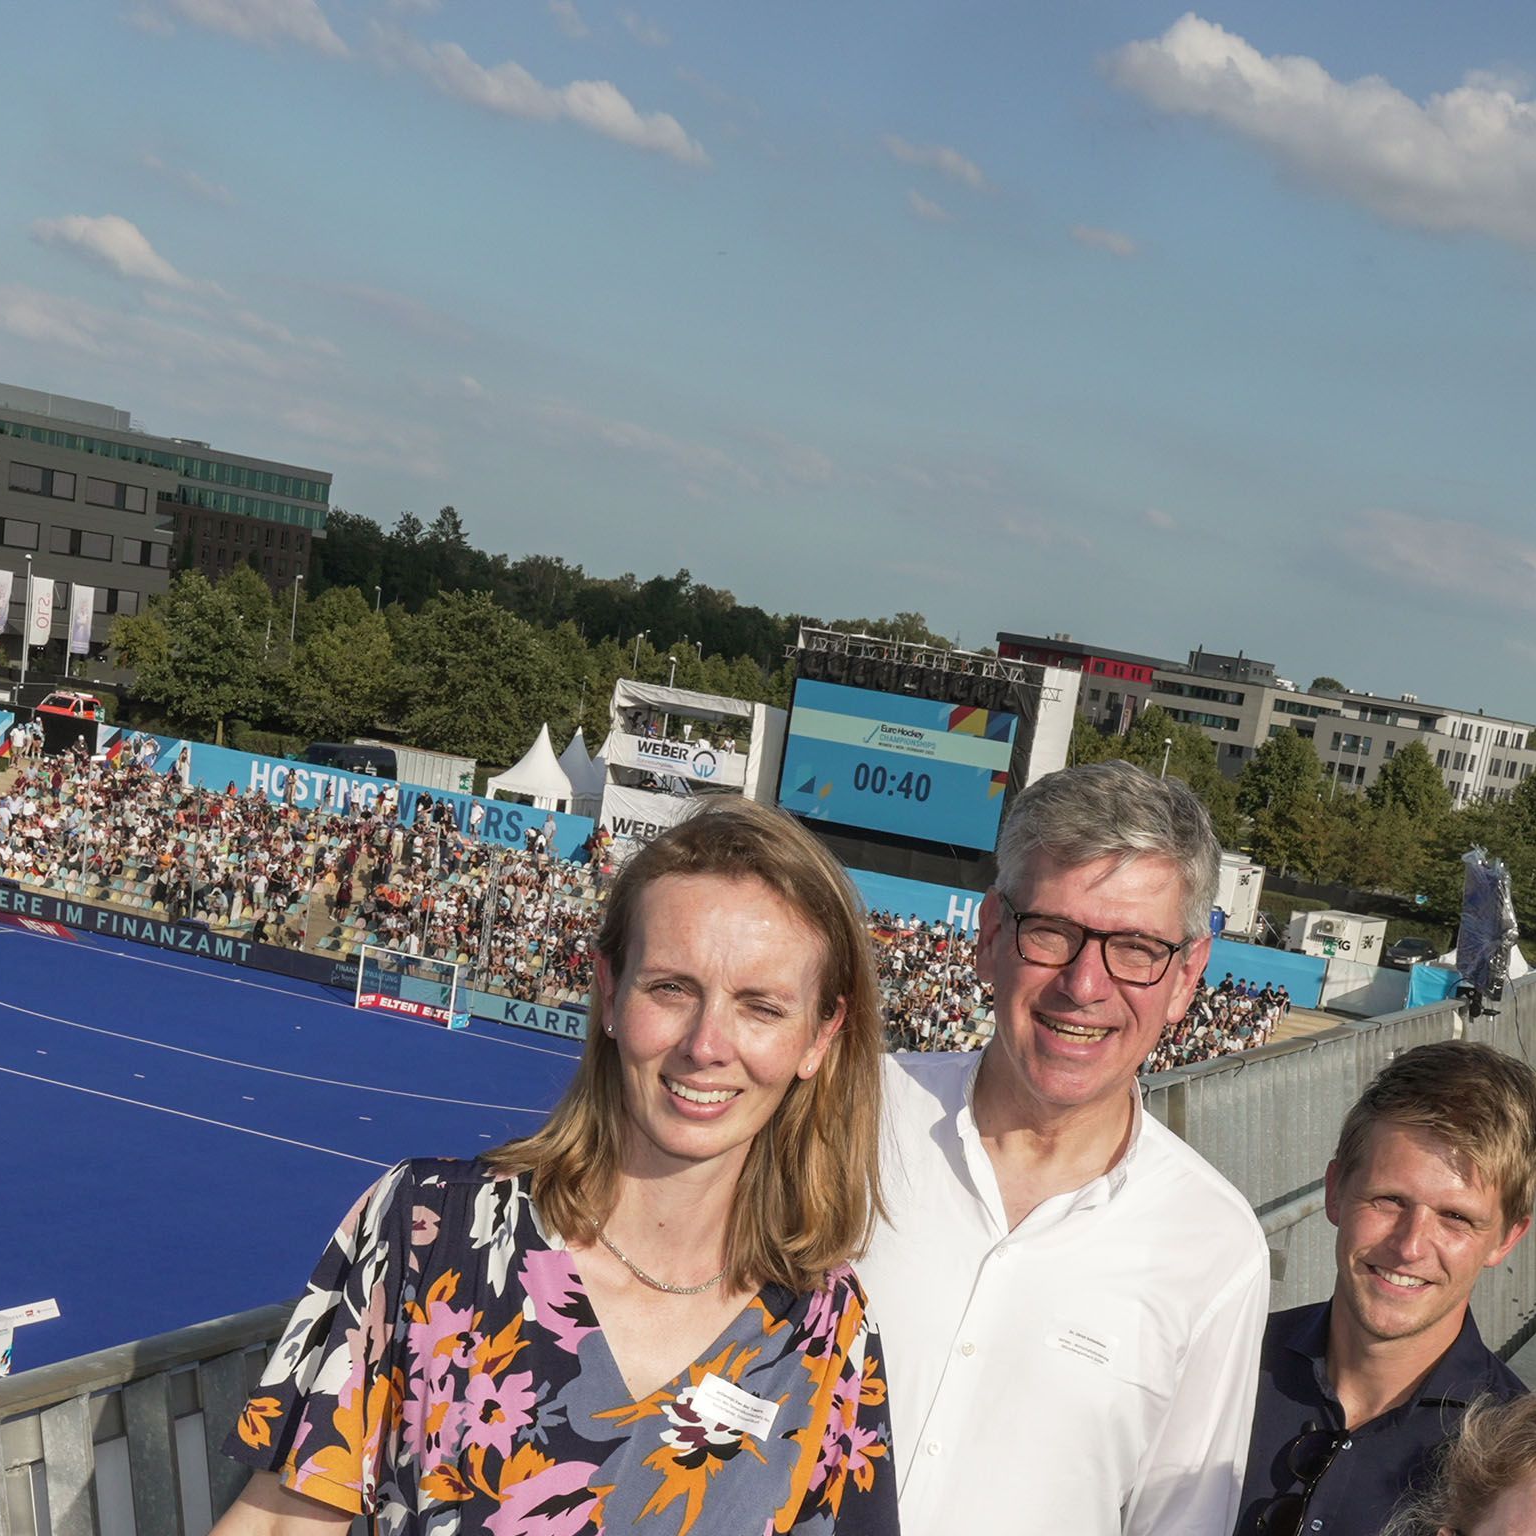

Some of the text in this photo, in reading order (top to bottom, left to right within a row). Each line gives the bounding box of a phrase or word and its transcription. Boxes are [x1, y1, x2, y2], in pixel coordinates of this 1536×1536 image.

[638, 740, 689, 761] WEBER
[250, 759, 378, 810] HOSTING
[854, 762, 932, 802] 00:40
[612, 816, 669, 839] WEBE
[17, 917, 61, 937] NEW
[56, 902, 83, 925] IM
[97, 911, 252, 962] FINANZAMT
[379, 996, 418, 1014] ELTEN
[422, 1005, 451, 1021] ELTE
